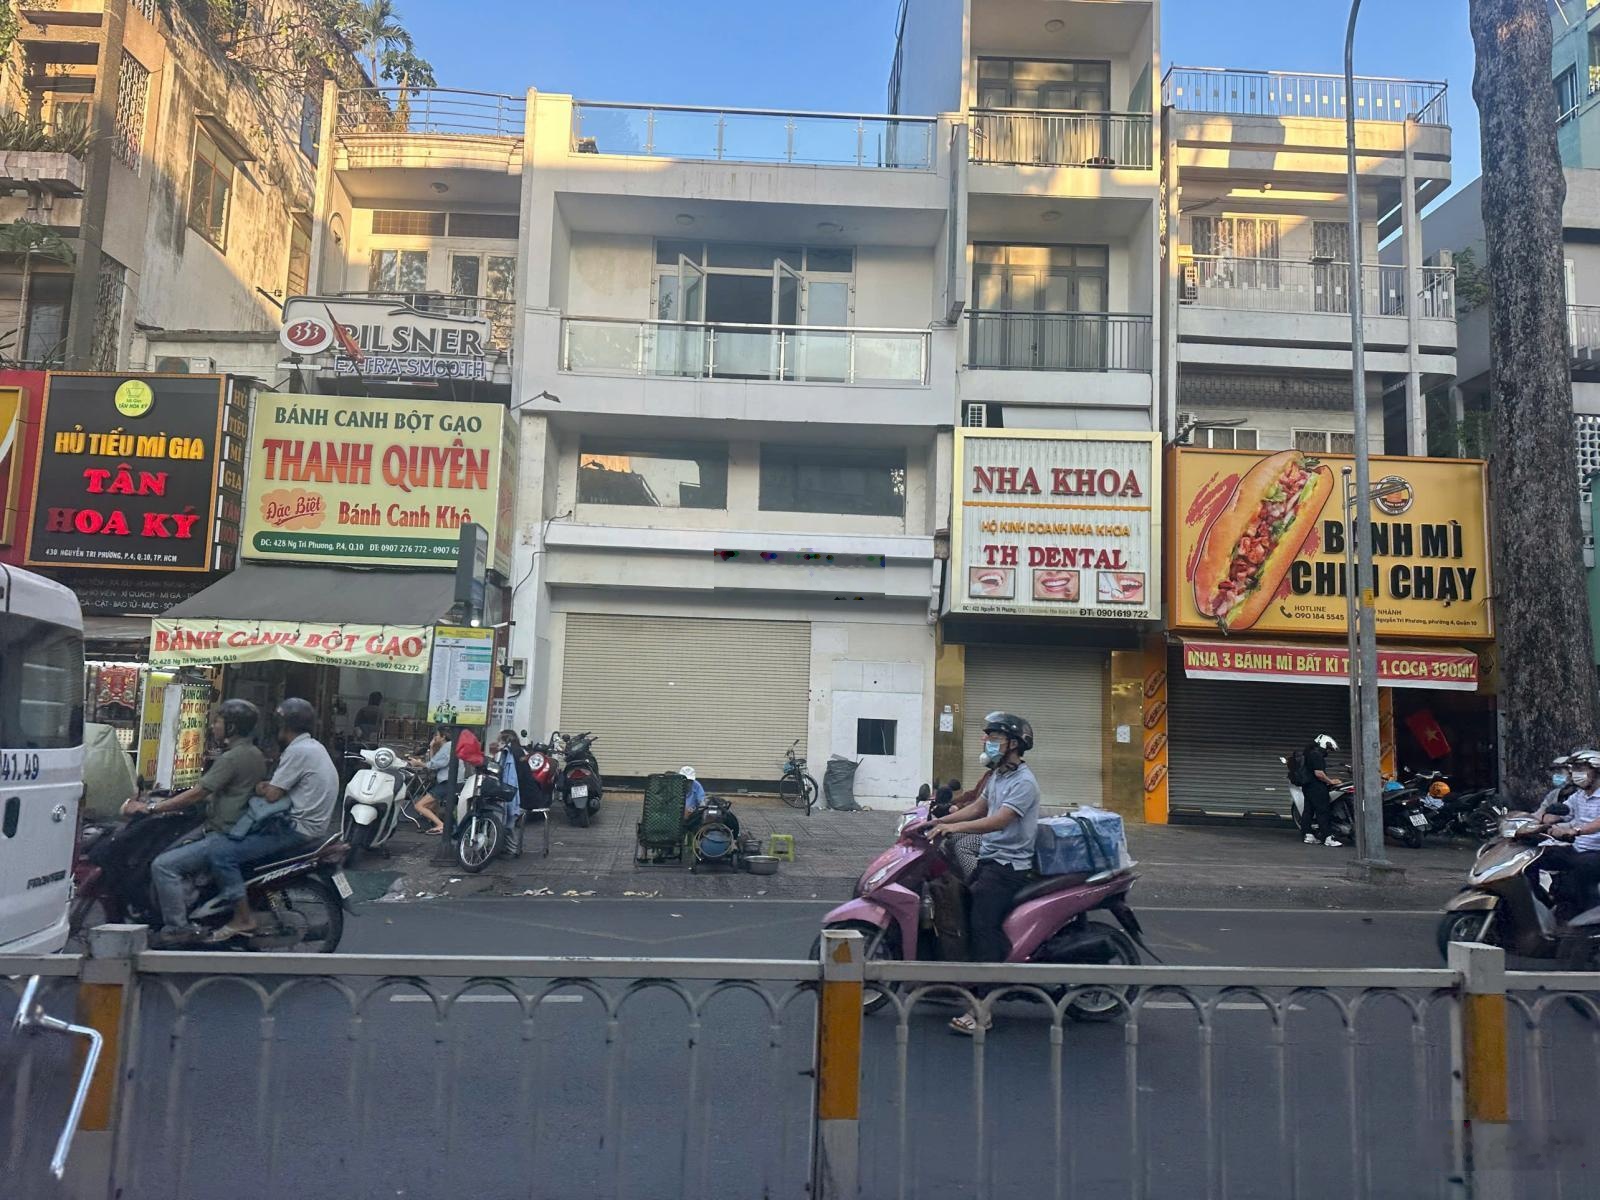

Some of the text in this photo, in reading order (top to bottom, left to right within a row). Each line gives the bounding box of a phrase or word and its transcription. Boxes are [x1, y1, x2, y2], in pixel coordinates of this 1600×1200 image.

[294, 318, 321, 341] 333
[334, 323, 485, 356] PILSNER
[334, 354, 487, 379] EXTRA SMOOTH
[275, 403, 482, 436] BÁNH CANH BỘT GẠO
[54, 424, 86, 454] HỦ
[136, 431, 166, 459] MÌ
[169, 437, 205, 460] GIA
[83, 462, 169, 496] TÂN
[262, 437, 490, 493] THANH QUYÊN
[225, 470, 243, 491] GIA
[972, 465, 1143, 498] NHA KHOA
[46, 504, 201, 539] HOA KÝ
[265, 496, 321, 520] Đặc Biệt
[338, 501, 472, 529] Bánh Canh Khô
[980, 519, 1131, 538] HỘ KINH DOANH NHA KHOA
[1322, 517, 1463, 559] BNH MÌ
[45, 548, 58, 556] 430
[60, 547, 84, 558] NGUYỄN
[163, 554, 177, 563] HCM
[273, 539, 286, 547] 428
[287, 540, 297, 549] Ng
[381, 544, 398, 553] 0907
[399, 545, 413, 553] 276
[414, 545, 428, 554] 772
[433, 546, 449, 554] 0907
[984, 545, 1128, 569] TH DENTAL
[1389, 563, 1477, 608] CHẠY
[1294, 604, 1327, 612] HOTLINE
[1295, 611, 1345, 621] 090 184 5545
[1378, 608, 1402, 616] NHÁNH
[226, 631, 299, 648] CANH
[303, 630, 360, 655] BỘT
[365, 634, 424, 660] GẠO
[1187, 650, 1219, 668] MUA
[1222, 652, 1231, 668] 3
[1234, 651, 1272, 670] BÁNH
[1276, 652, 1293, 671] MÌ
[1296, 652, 1322, 673] BẤT
[1325, 653, 1339, 673] KÌ
[1381, 660, 1388, 675] 1
[1391, 660, 1427, 676] COCA
[1431, 661, 1477, 679] 390ML
[0, 753, 39, 781] 41.49
